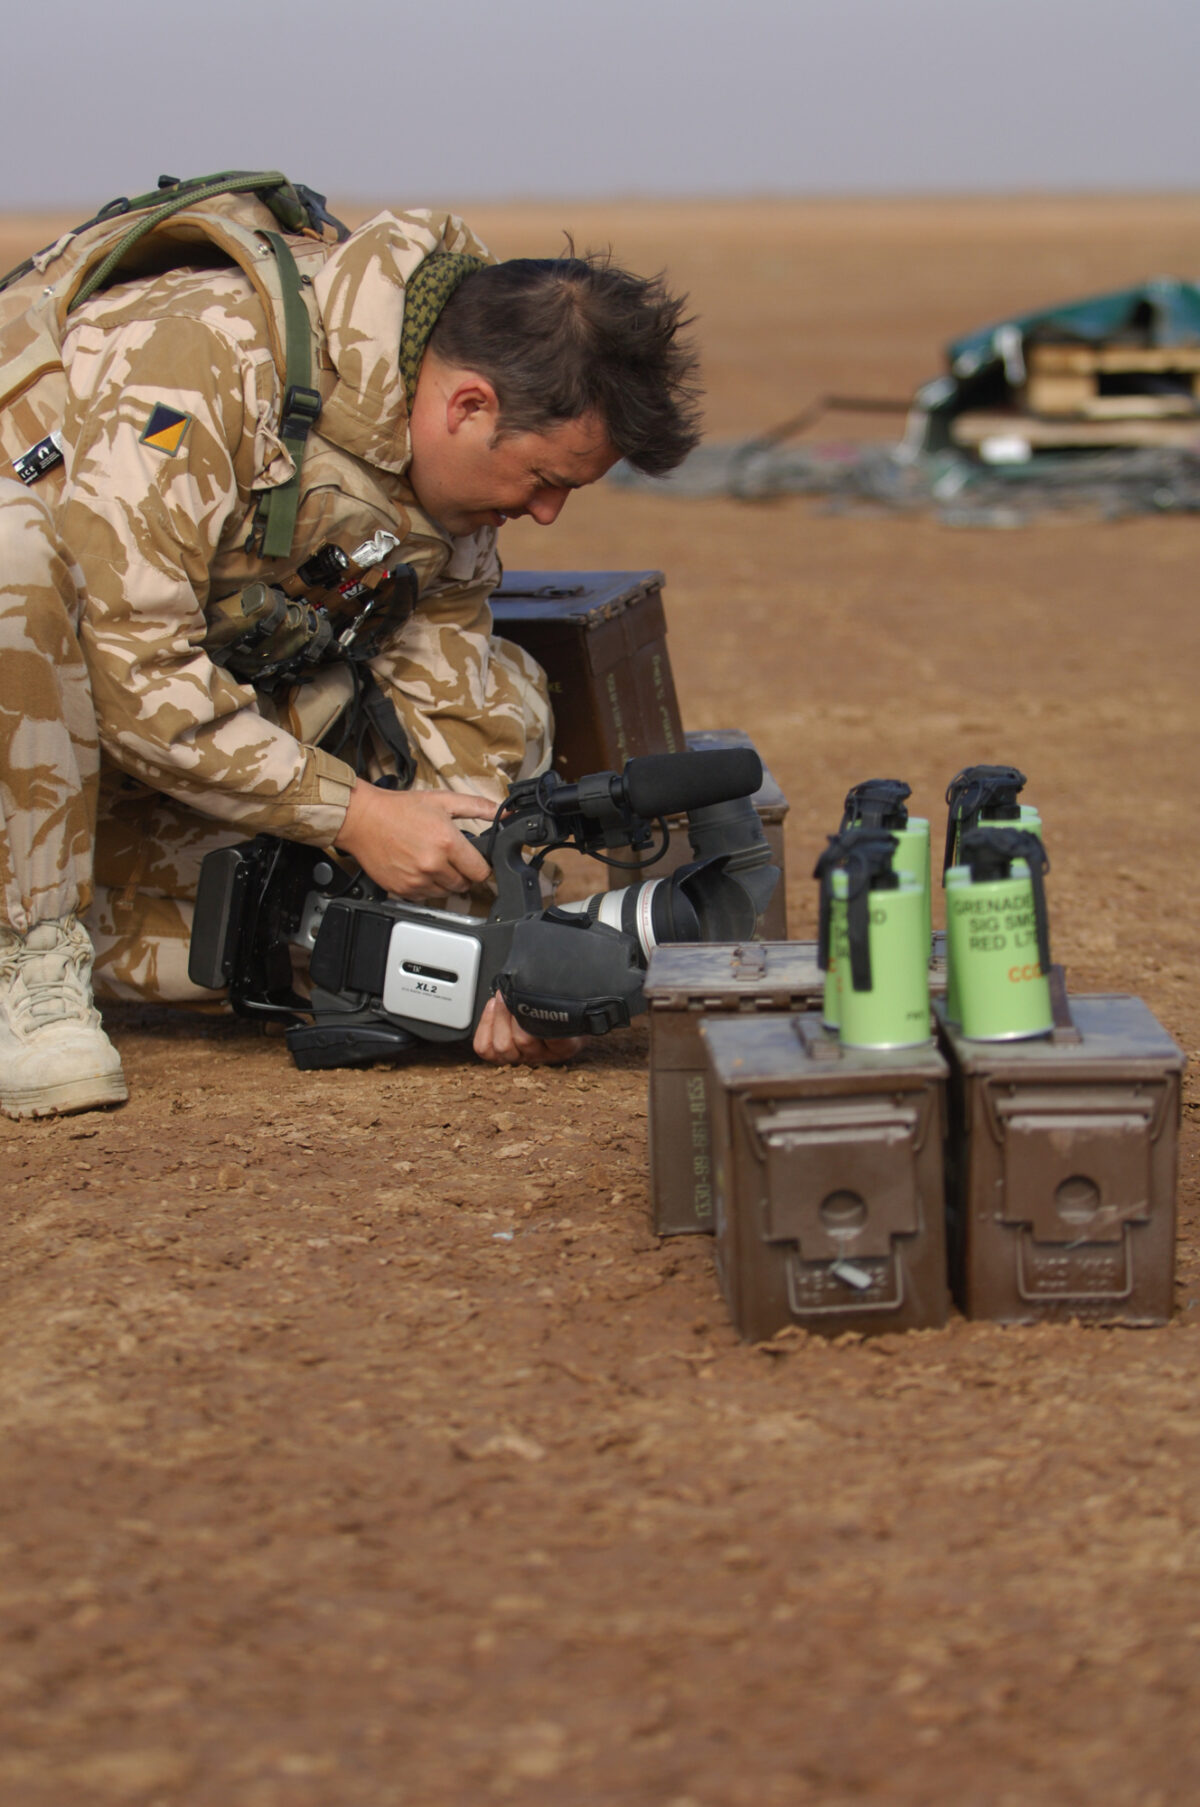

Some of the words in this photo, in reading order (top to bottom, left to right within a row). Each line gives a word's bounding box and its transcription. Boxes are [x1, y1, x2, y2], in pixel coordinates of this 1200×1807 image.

[969, 917, 1000, 933] SIG
[969, 934, 1007, 949] RED
[518, 1003, 569, 1022] Canon
